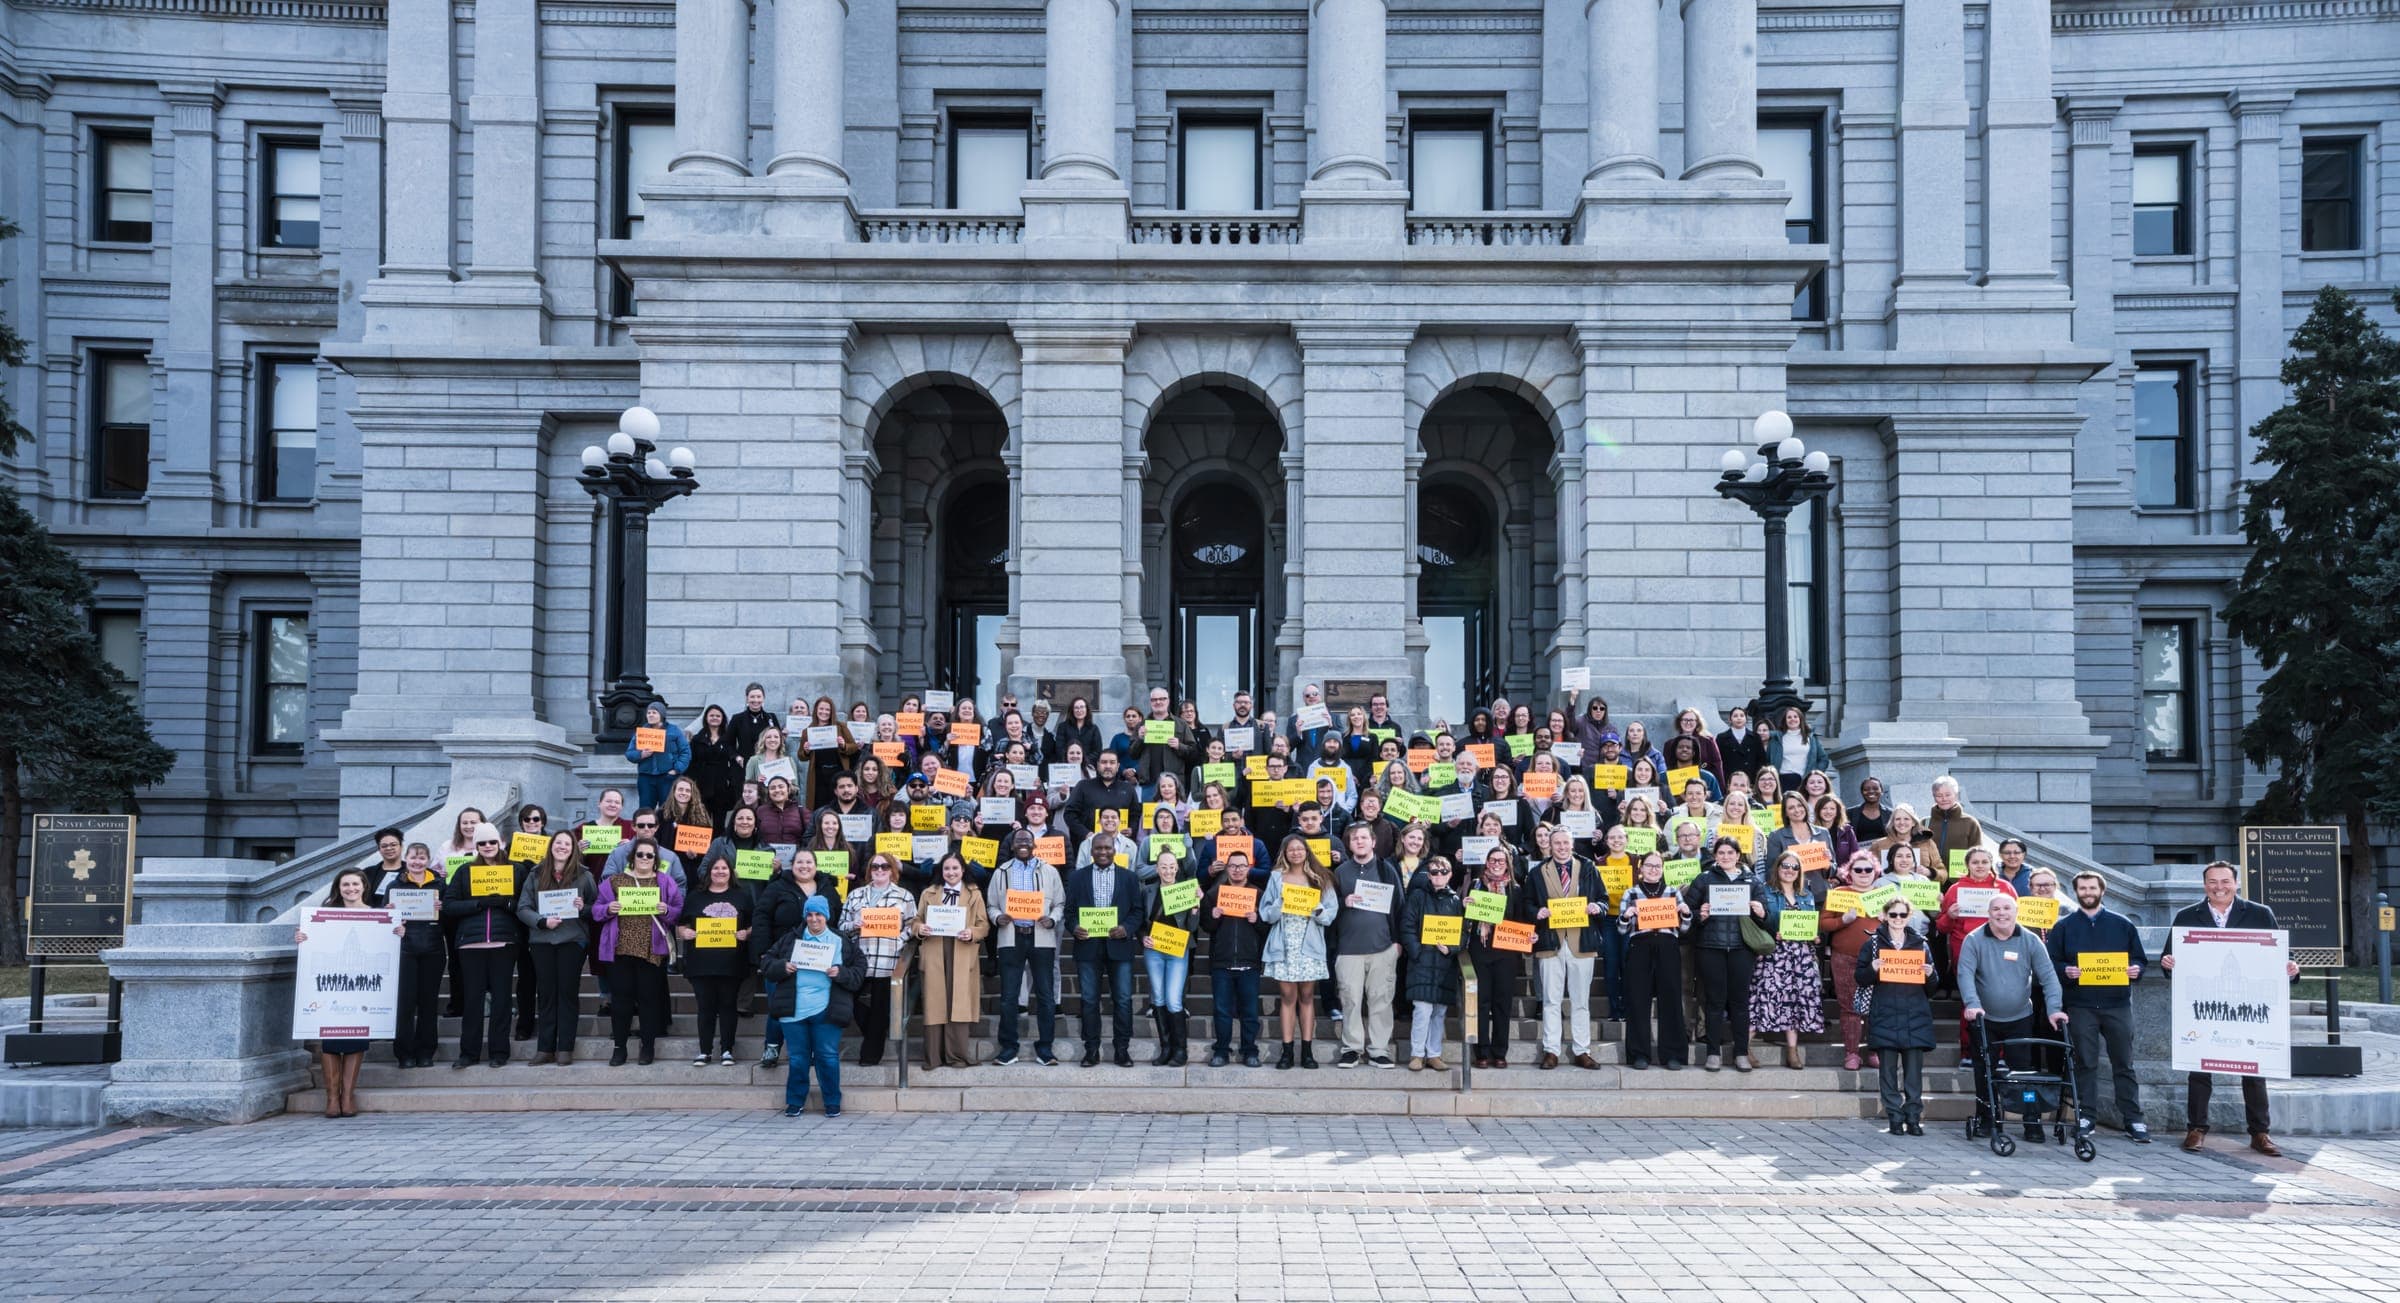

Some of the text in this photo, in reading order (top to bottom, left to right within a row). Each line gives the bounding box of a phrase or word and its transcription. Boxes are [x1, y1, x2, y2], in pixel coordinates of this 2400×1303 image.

[938, 772, 967, 784] MEDICAID
[937, 780, 964, 790] MATTERS
[1393, 791, 1420, 806] EMPOWER
[1398, 802, 1408, 810] ALL
[2264, 832, 2333, 840] STATE CAPITOL
[517, 837, 547, 845] PROTECT
[678, 839, 708, 848] MATTERS
[967, 840, 994, 848] PROTECT
[513, 852, 545, 860] SERVICES
[1665, 862, 1698, 870] EMPOWER
[1164, 884, 1196, 896] EMPOWER
[1287, 888, 1316, 896] PROTECT
[1175, 893, 1188, 901] ALL
[1221, 892, 1253, 901] MEDICAID
[1862, 888, 1895, 901] EMPOWER
[1168, 900, 1196, 911] ABILITIES
[2020, 900, 2054, 908] PROTECT
[1008, 906, 1041, 914] MATTERS
[1284, 904, 1310, 913] SERVICE
[1639, 905, 1675, 913] MEDICAID
[2017, 916, 2053, 924] SERVICES
[1497, 926, 1531, 937] MEDICAID
[1497, 935, 1530, 945] MATTERS
[1882, 967, 1922, 976] MATTERS
